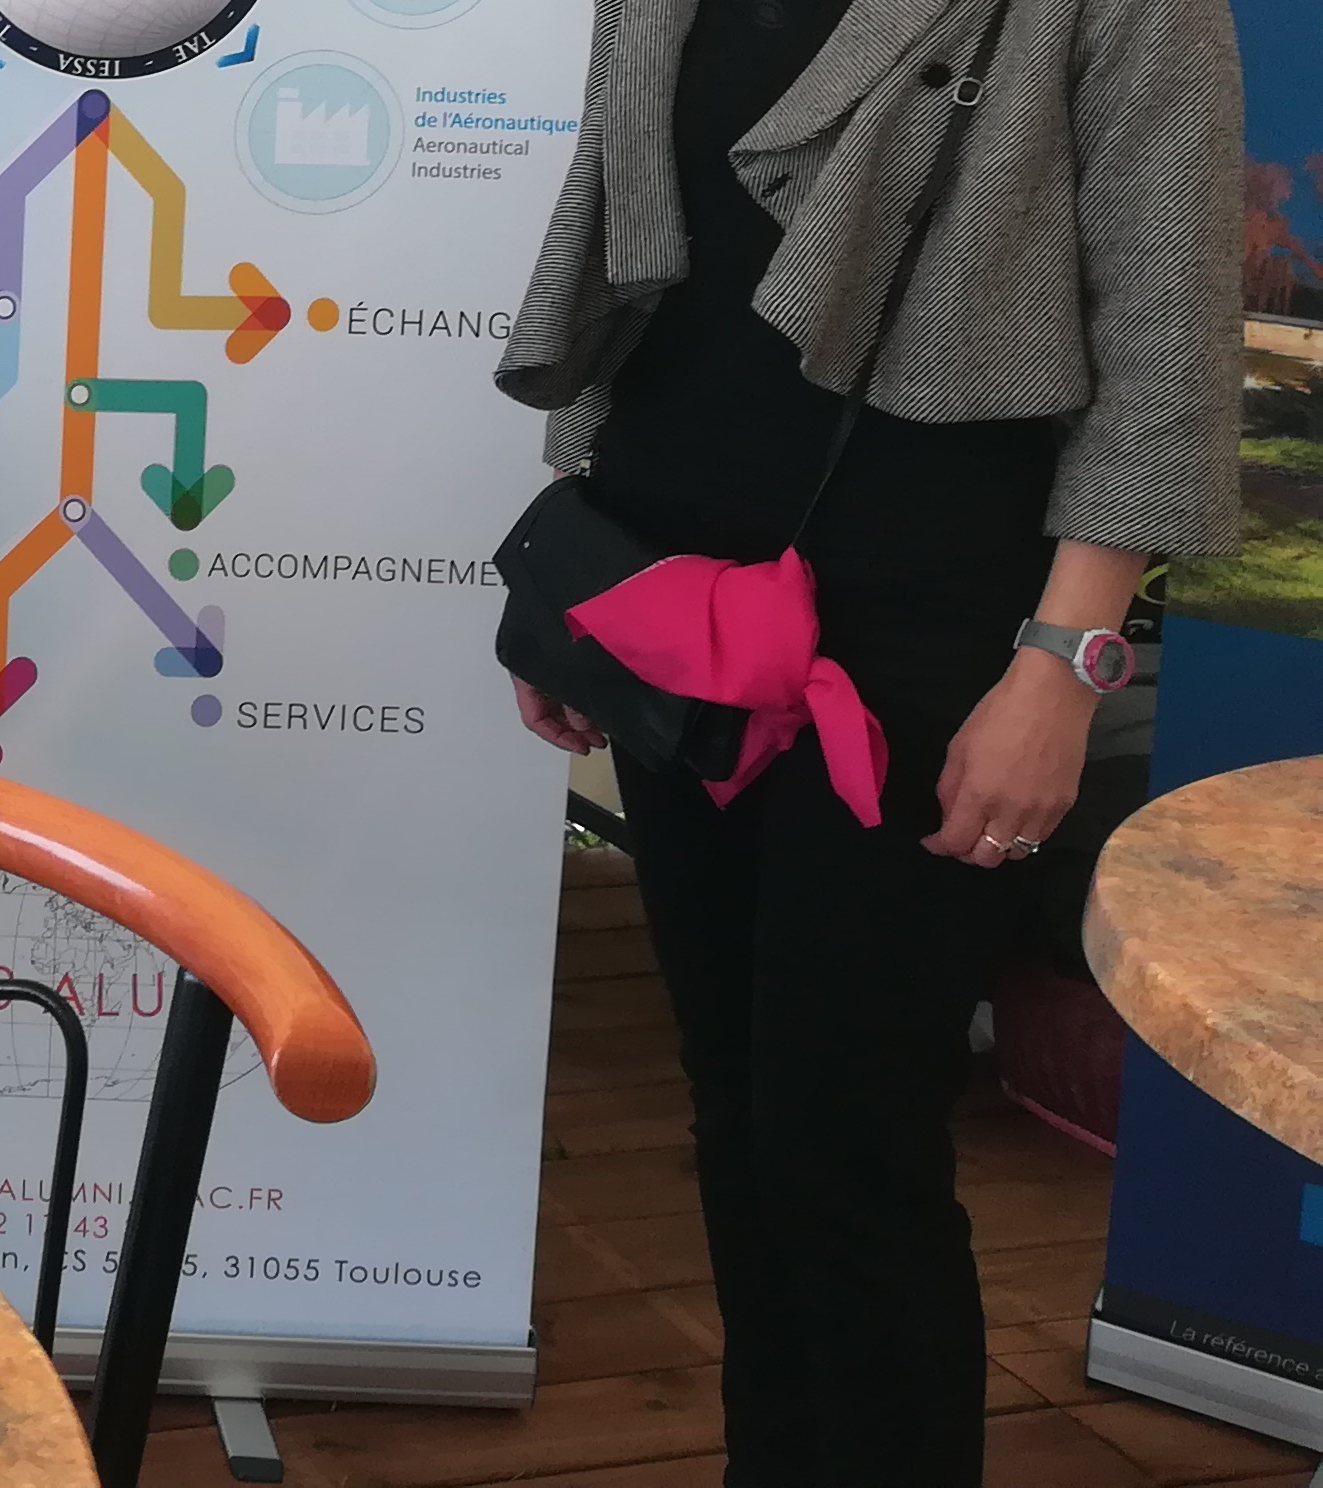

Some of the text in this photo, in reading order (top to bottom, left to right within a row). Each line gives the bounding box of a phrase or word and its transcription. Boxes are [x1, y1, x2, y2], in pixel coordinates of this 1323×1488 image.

[171, 30, 217, 64] TAE
[57, 53, 121, 77] IESSA
[415, 87, 507, 106] Industries
[414, 112, 578, 135] de l'Aéronautique
[413, 137, 530, 157] Aeronautical
[411, 162, 503, 181] Industries
[207, 553, 506, 589] ACCOMPAGNEME
[236, 701, 426, 734] SERVICES
[73, 1216, 109, 1239] 43
[62, 1249, 86, 1272] S
[223, 1255, 320, 1281] 31055
[334, 1260, 482, 1289] Toulouse
[1170, 1320, 1197, 1342] La
[1202, 1333, 1310, 1374] référence
